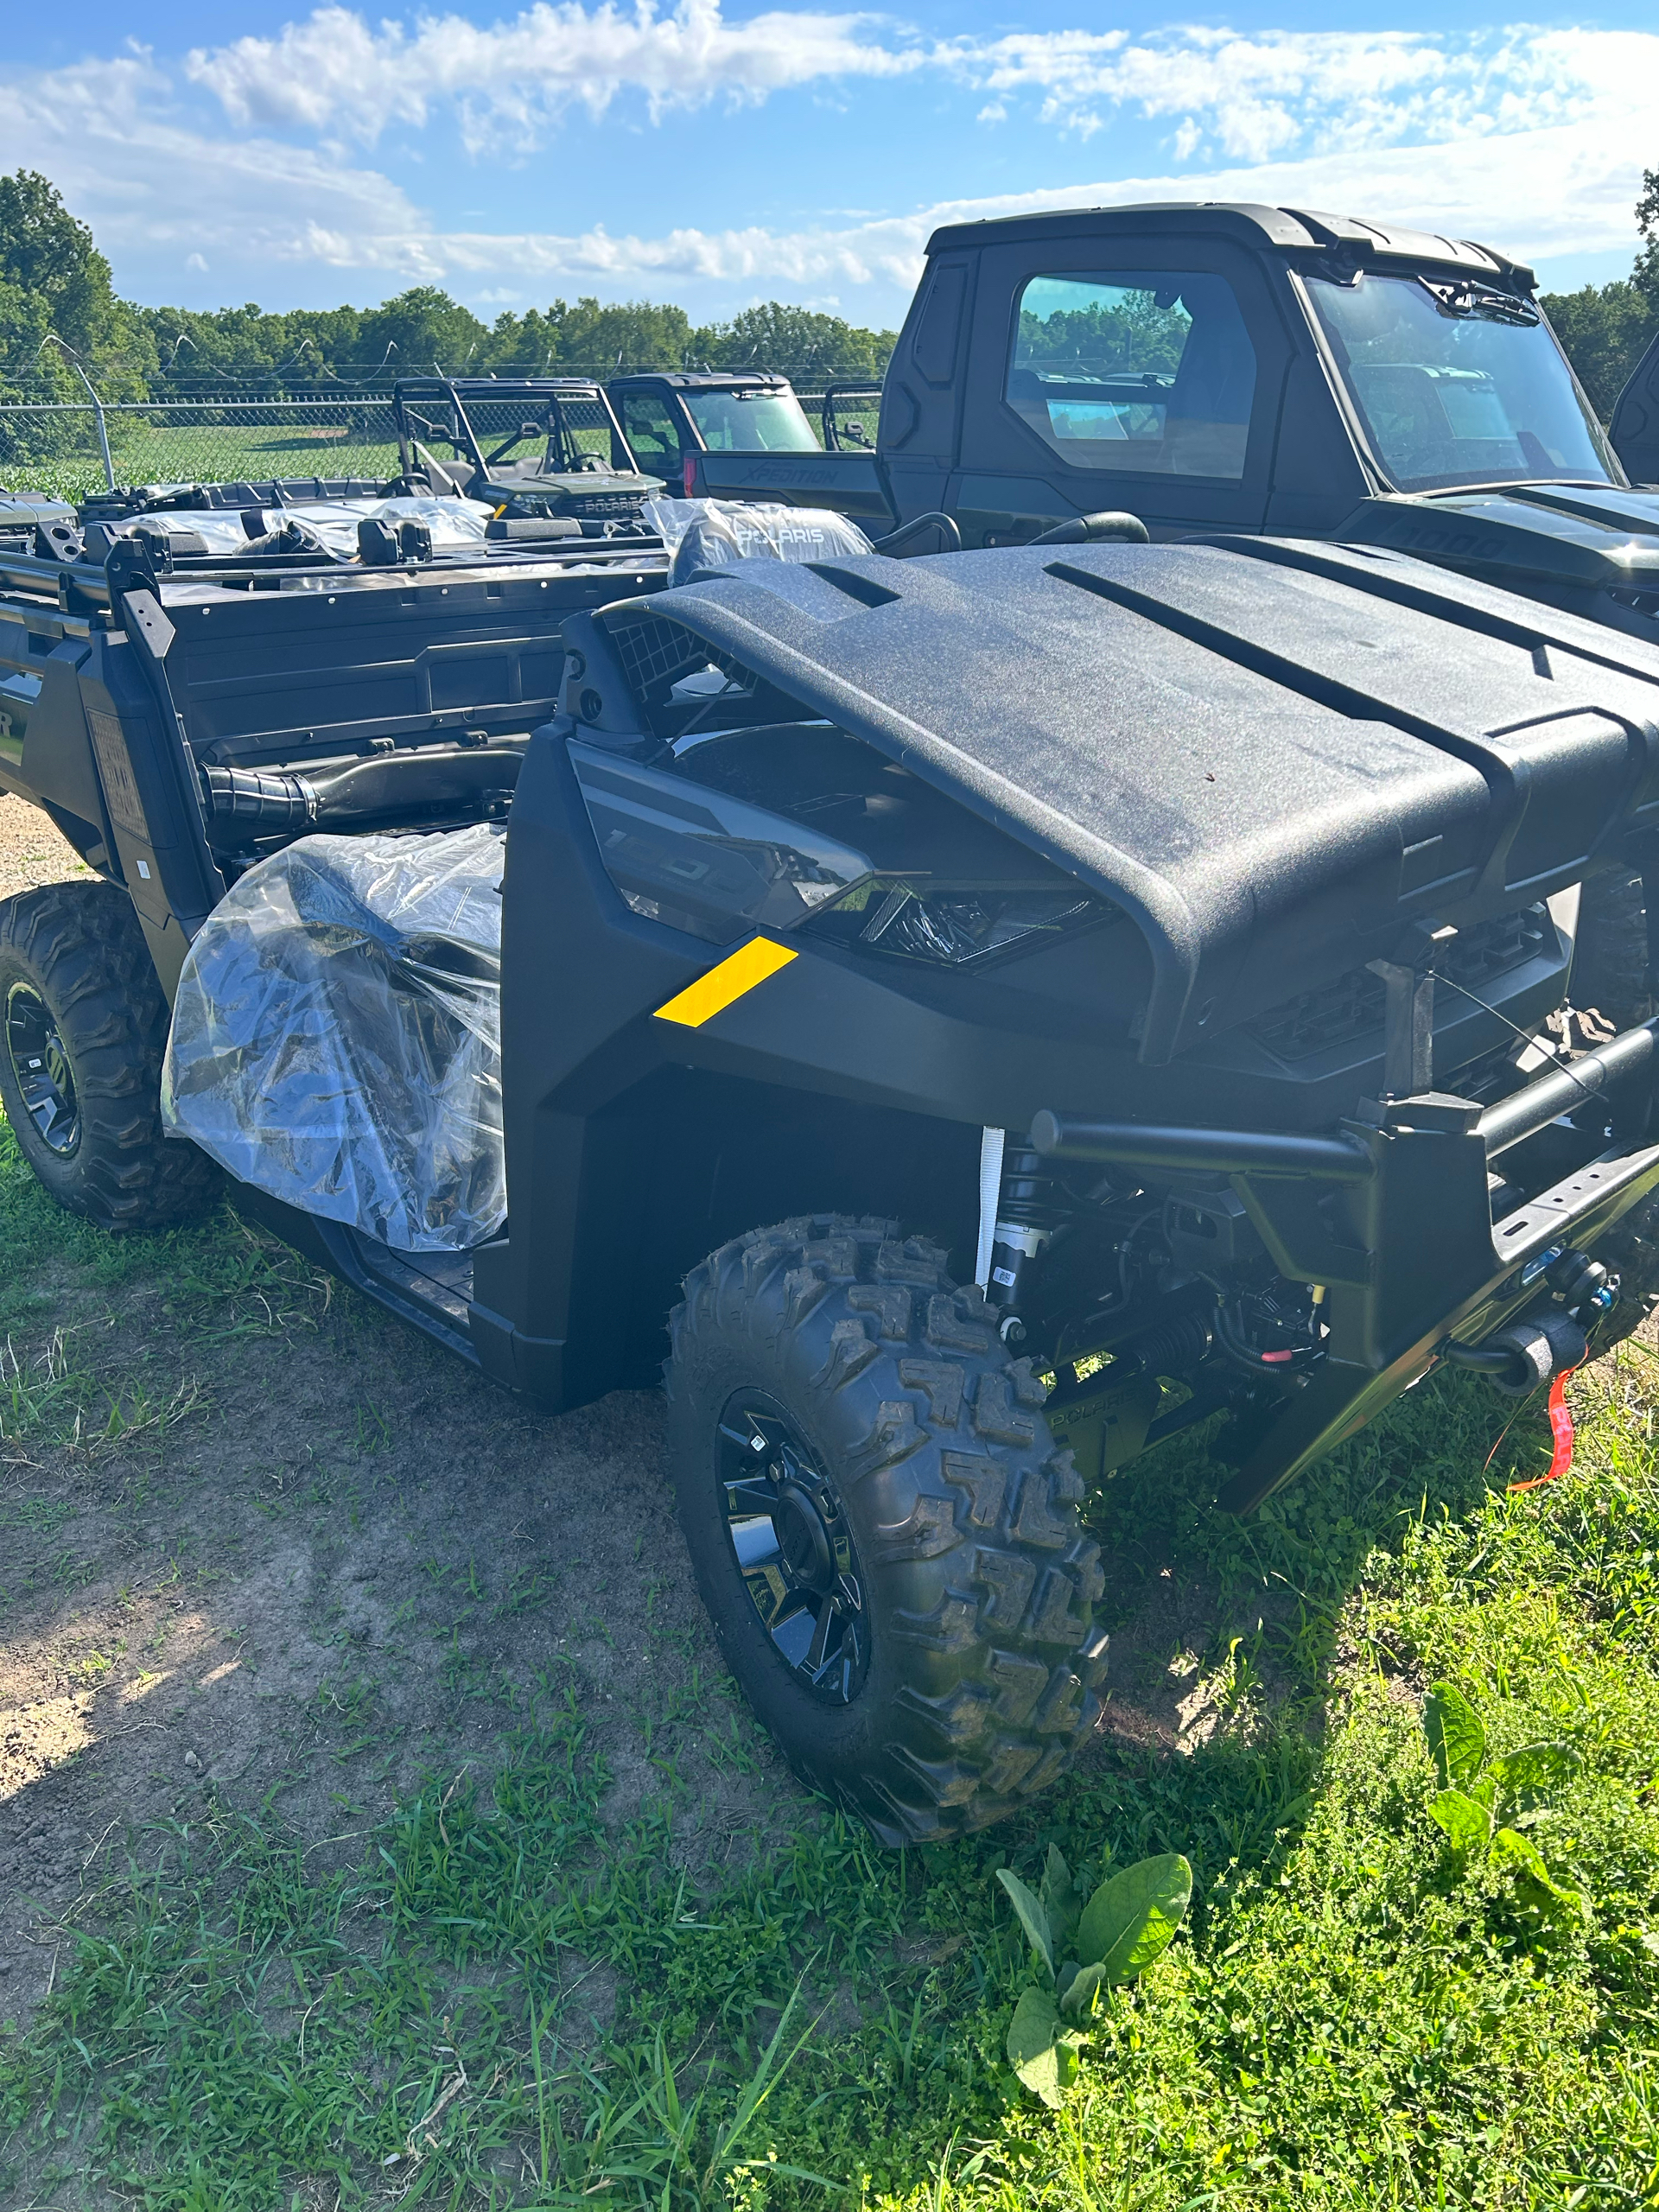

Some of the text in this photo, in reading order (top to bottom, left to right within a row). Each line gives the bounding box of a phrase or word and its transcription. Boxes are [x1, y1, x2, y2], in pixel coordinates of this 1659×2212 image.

[738, 461, 840, 484] XPEDITION
[585, 501, 639, 513] POLARIS
[737, 529, 824, 545] POLARIS
[1403, 526, 1509, 559] 1000
[1051, 1388, 1136, 1430] POLARIS
